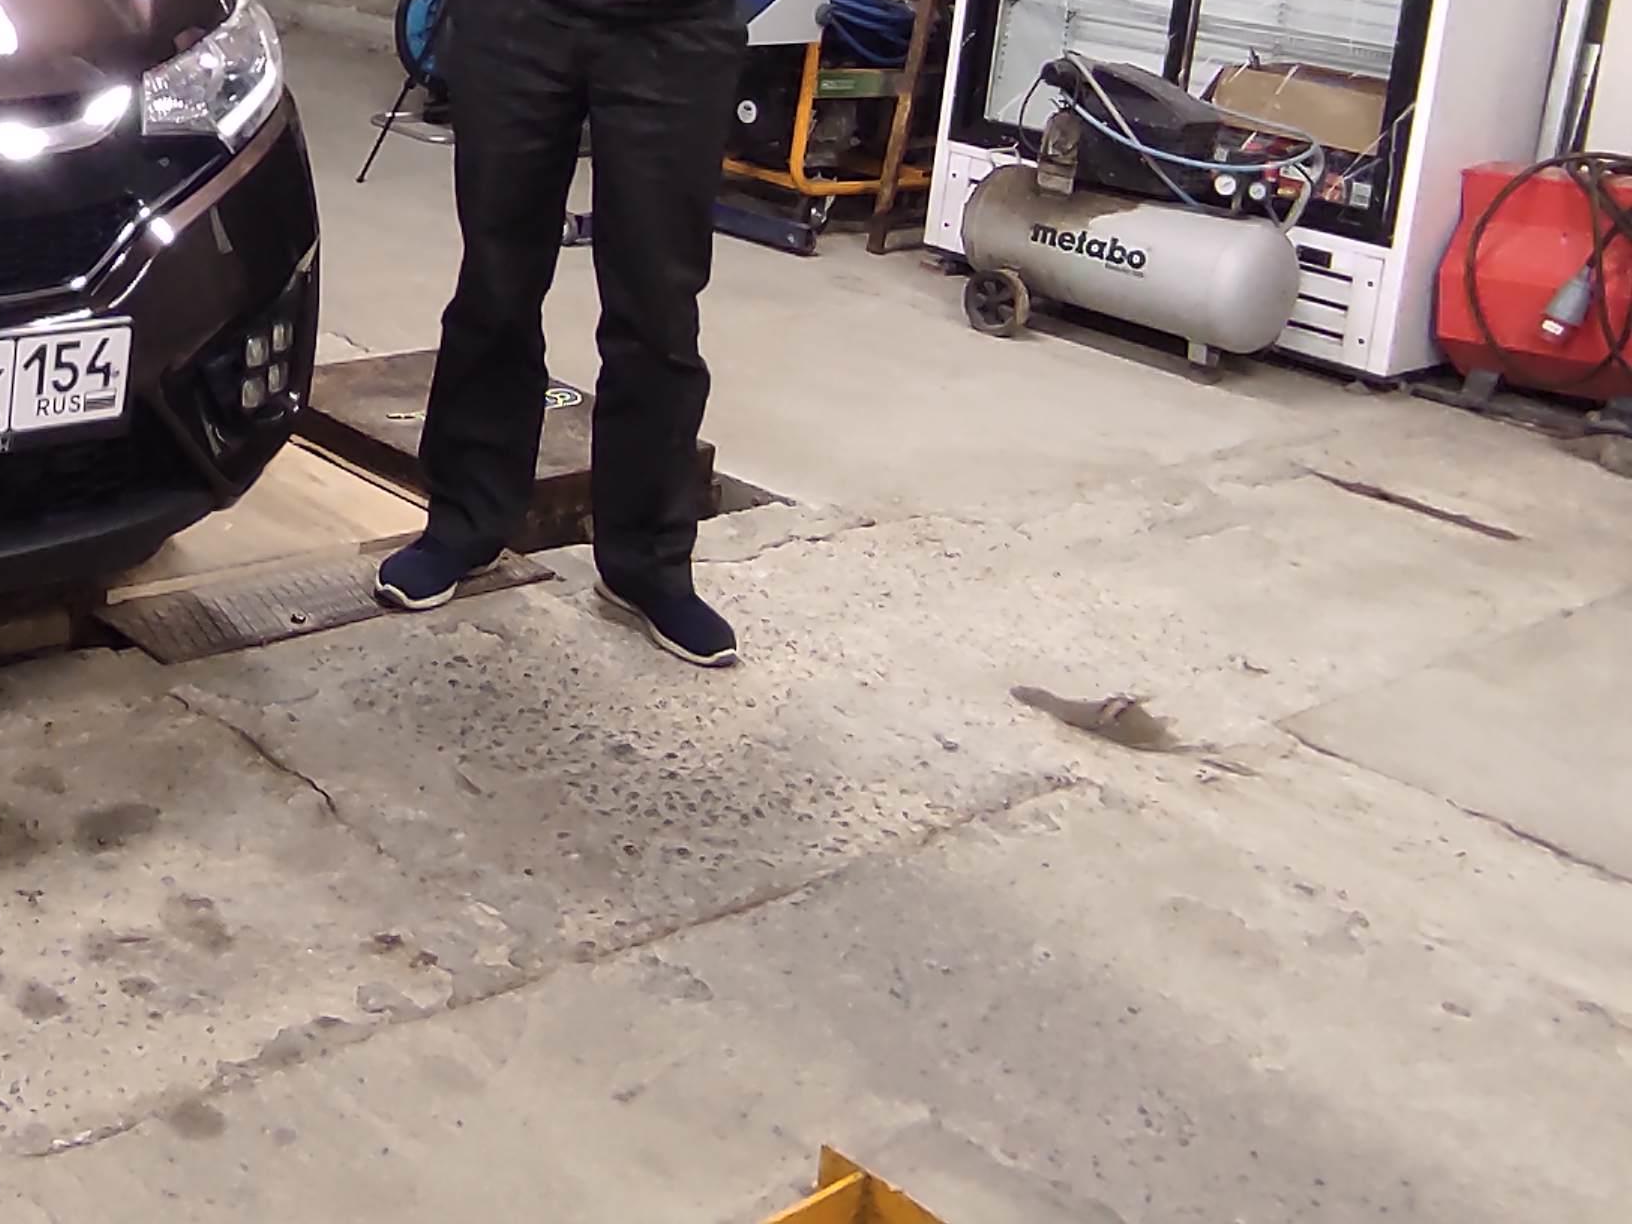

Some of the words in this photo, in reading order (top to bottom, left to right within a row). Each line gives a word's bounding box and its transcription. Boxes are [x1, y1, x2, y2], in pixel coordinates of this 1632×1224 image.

[1030, 223, 1147, 269] metabo
[23, 337, 111, 395] 154
[36, 394, 81, 416] RUS
